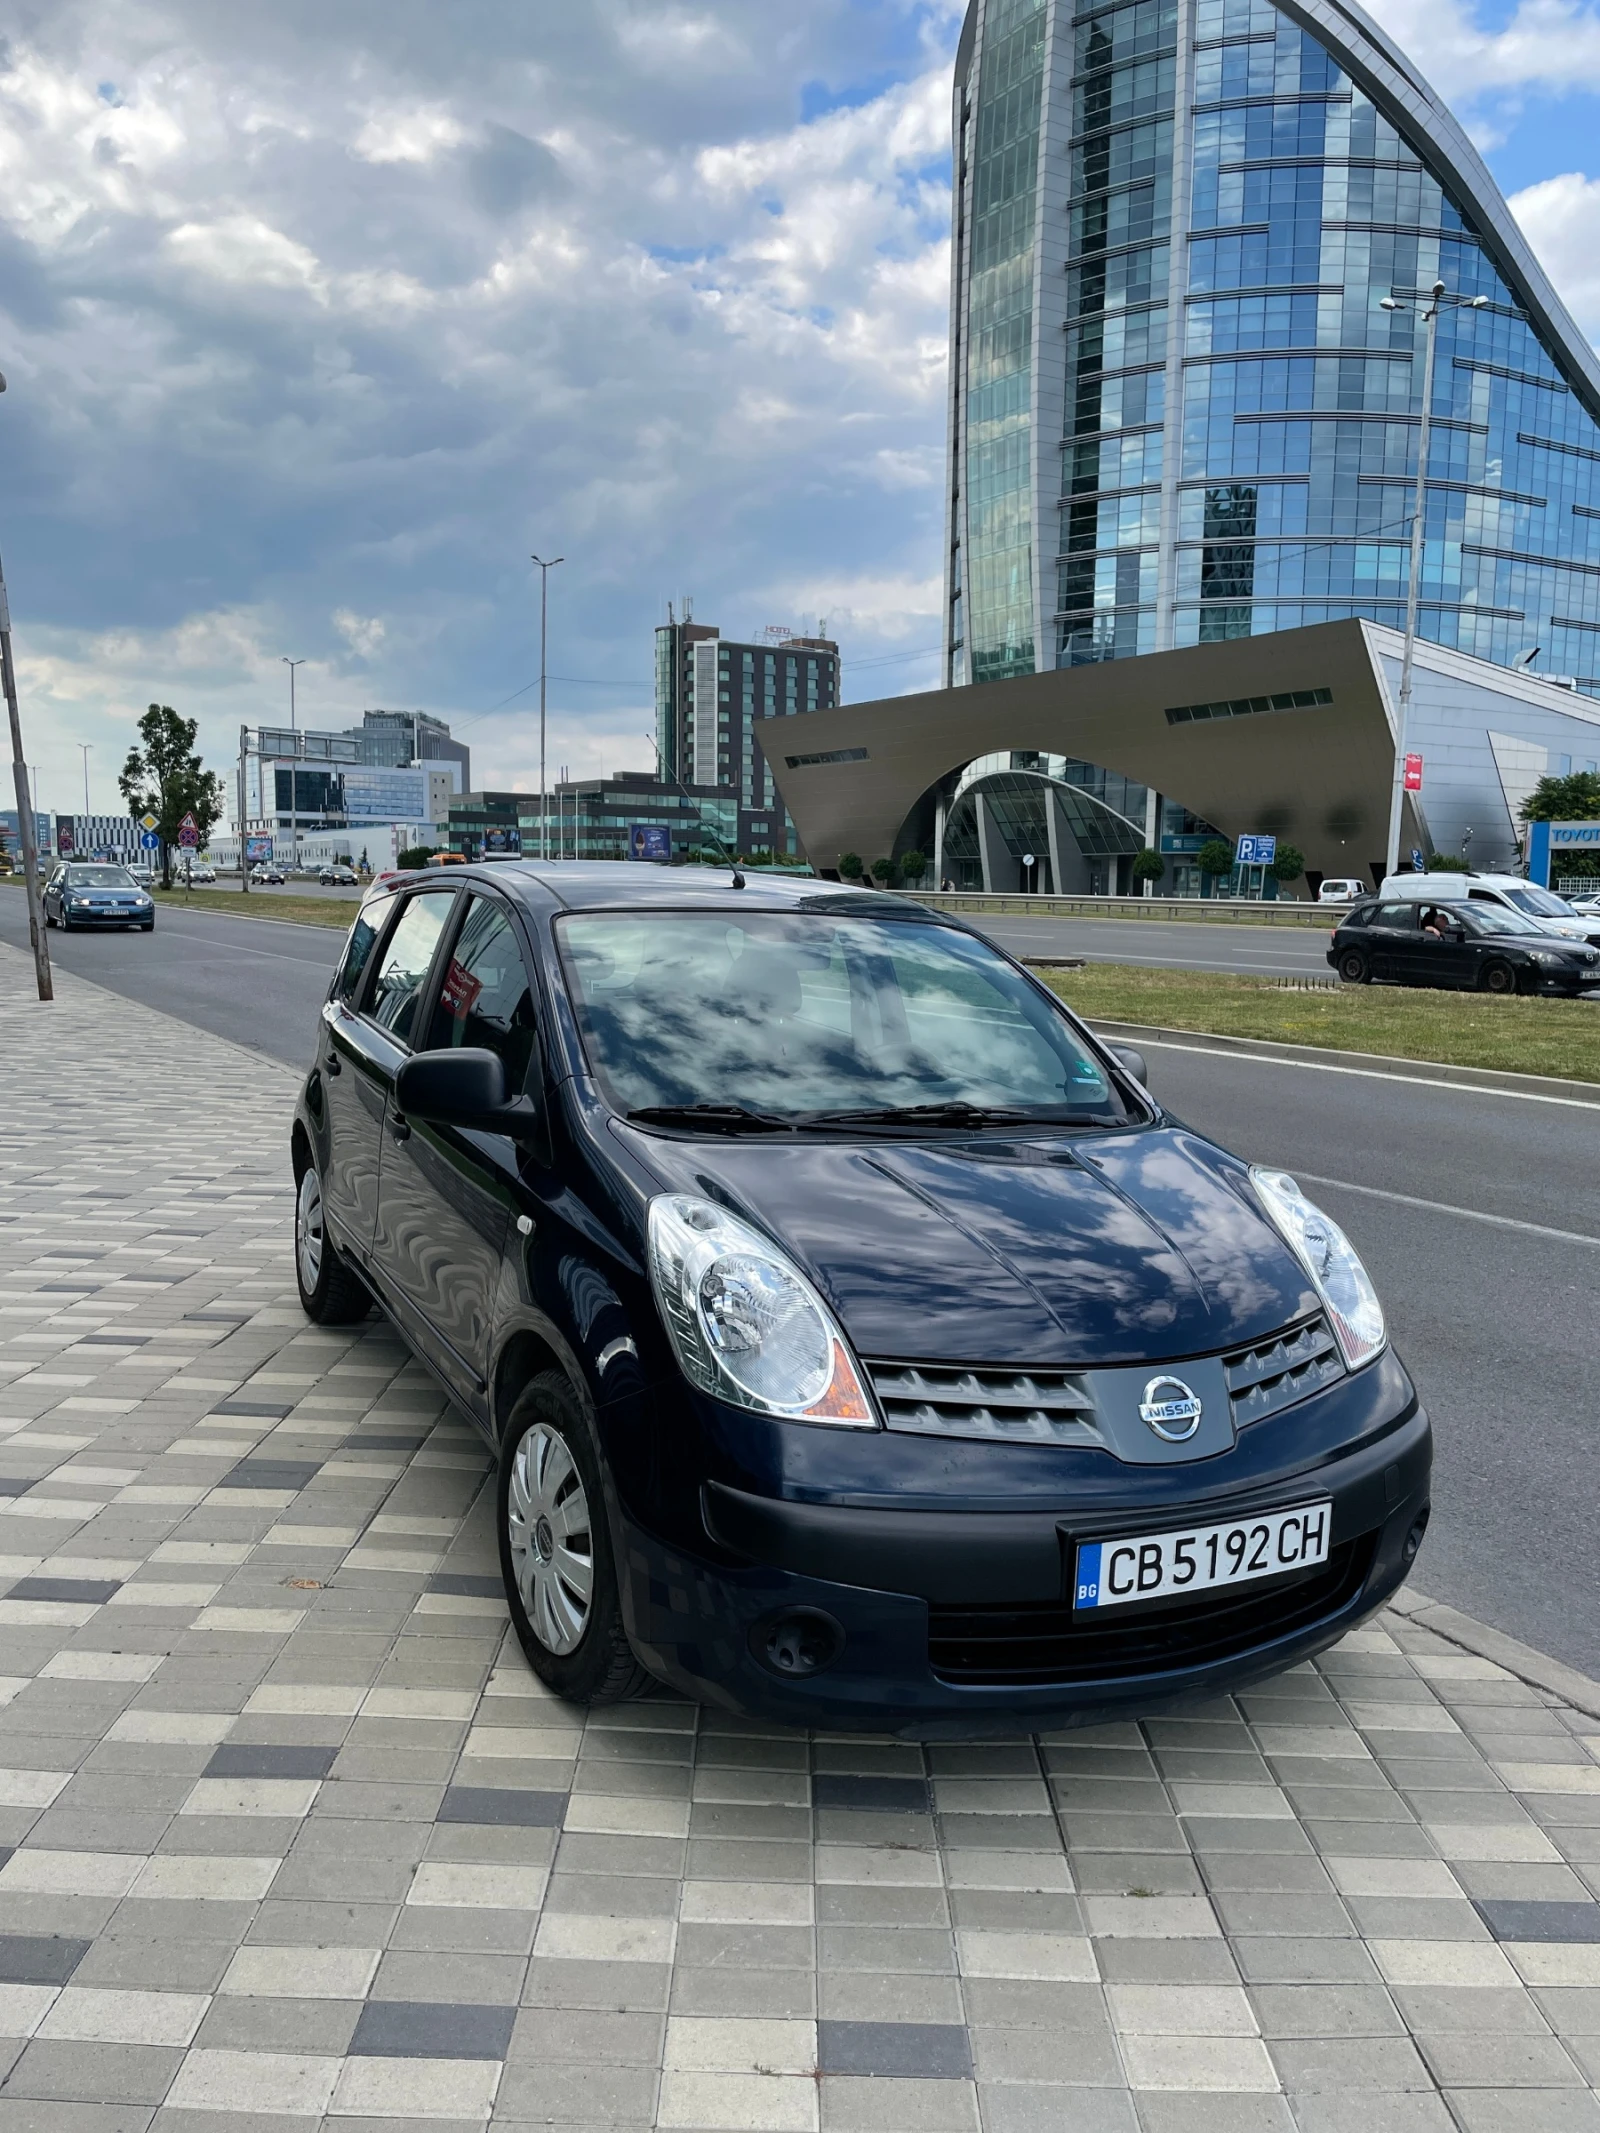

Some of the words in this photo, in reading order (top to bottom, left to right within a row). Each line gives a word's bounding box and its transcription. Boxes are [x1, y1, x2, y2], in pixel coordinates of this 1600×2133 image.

[1240, 840, 1253, 859] P
[1148, 1401, 1199, 1418] NISSAN
[1108, 1511, 1325, 1595] CB5192CH
[1078, 1584, 1097, 1600] BG
